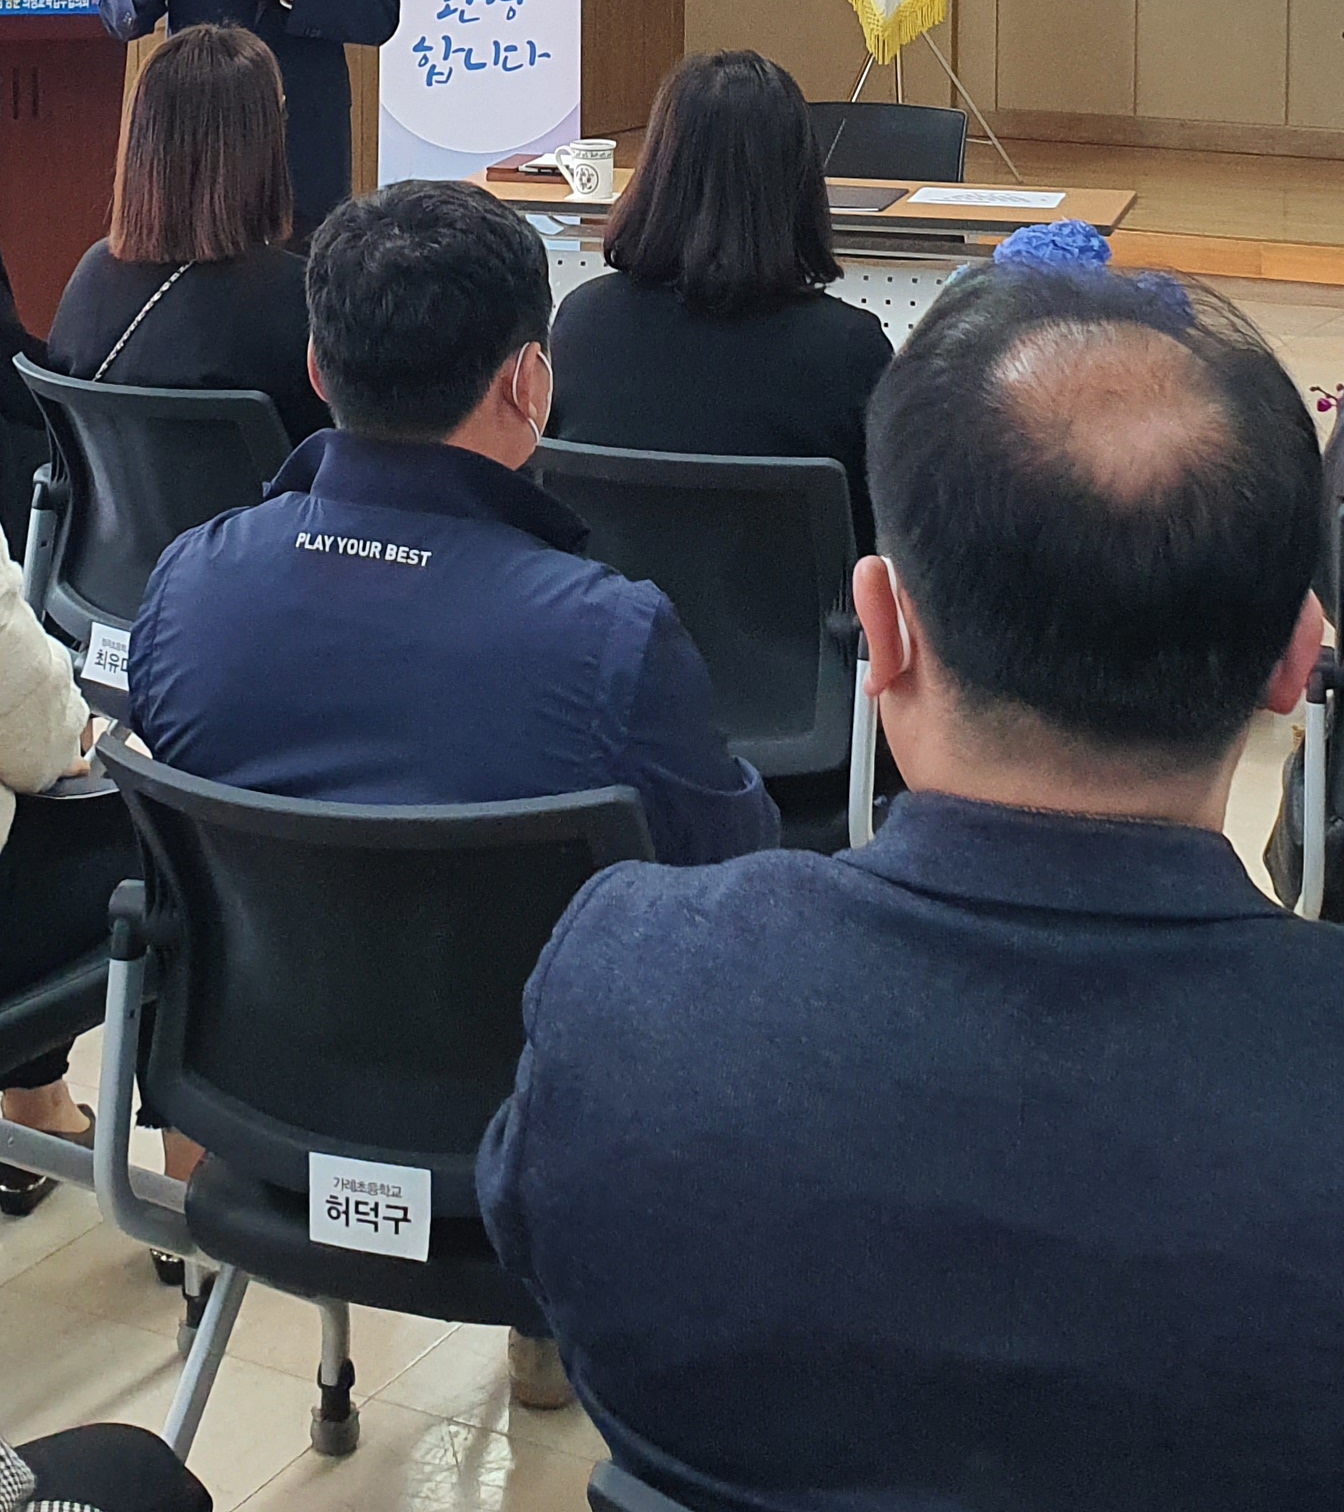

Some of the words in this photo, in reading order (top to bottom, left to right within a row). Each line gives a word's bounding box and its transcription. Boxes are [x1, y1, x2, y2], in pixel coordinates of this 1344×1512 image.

[412, 34, 552, 87] 합니다
[295, 533, 334, 553] PLAY
[336, 537, 381, 559] YOUR
[384, 544, 432, 567] BEST
[325, 1194, 412, 1235] 허덕구
